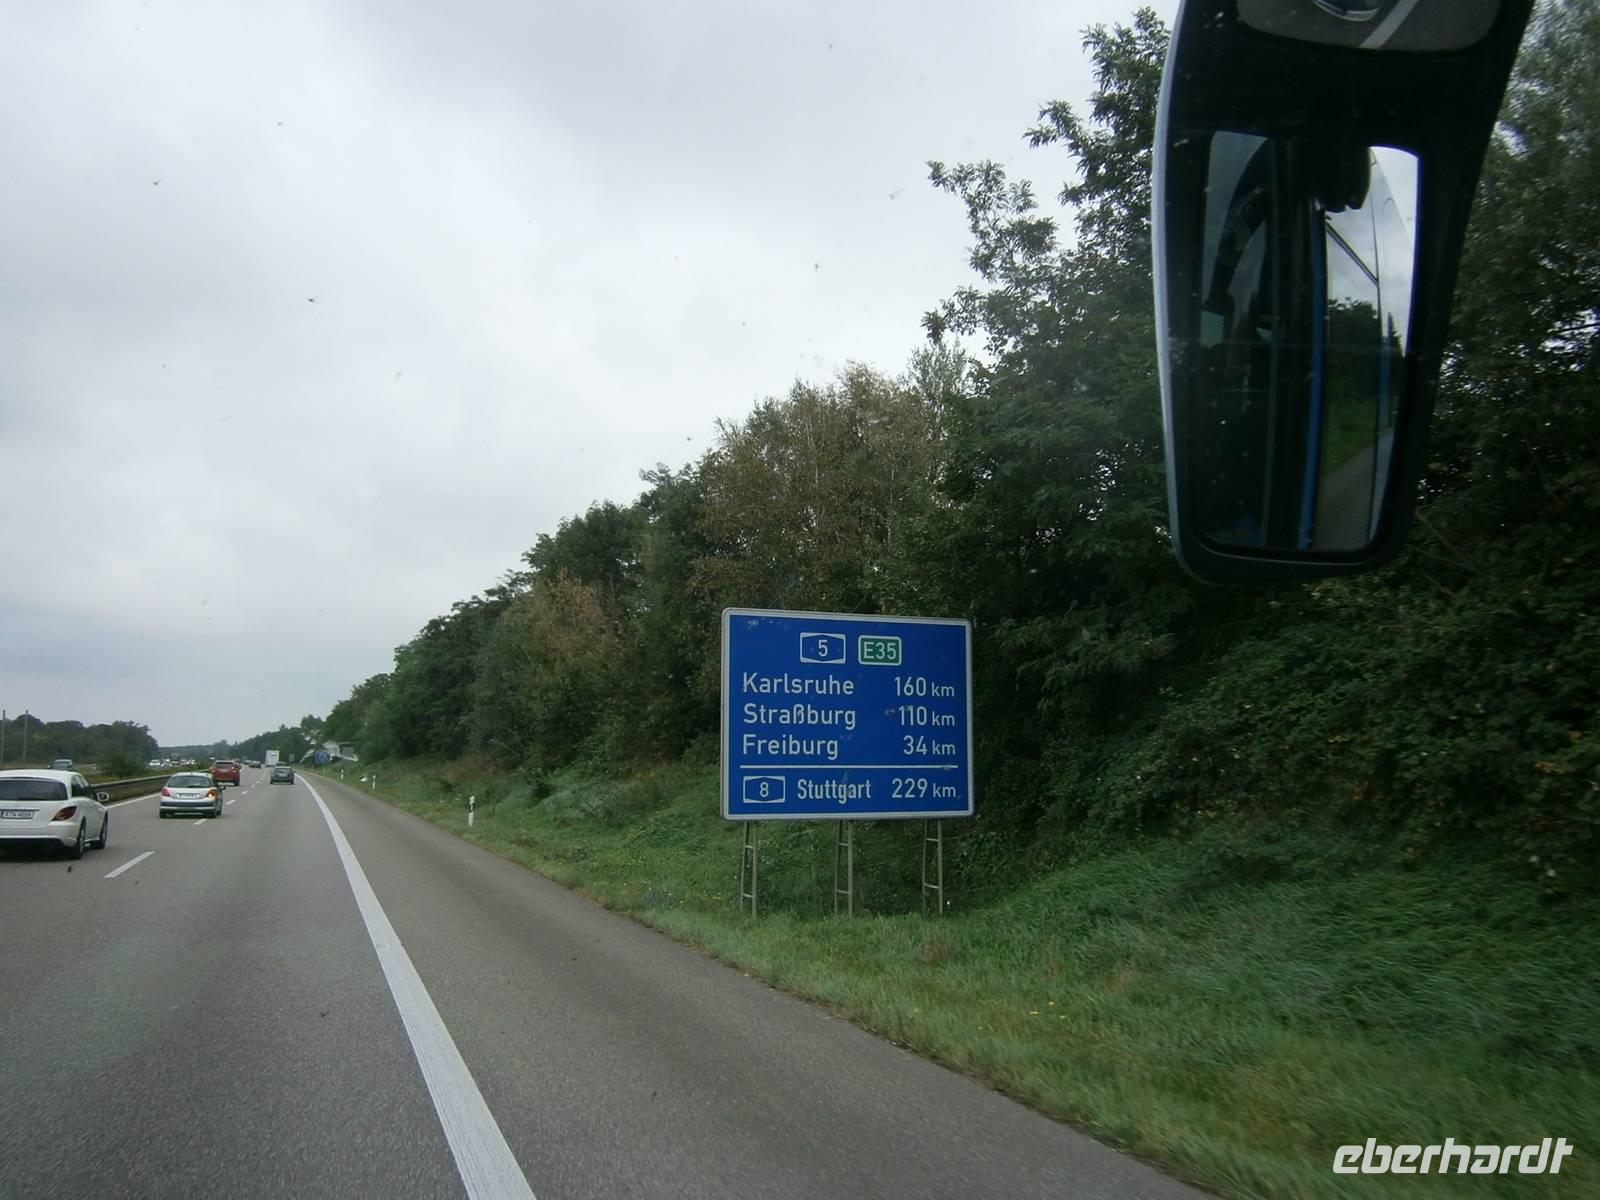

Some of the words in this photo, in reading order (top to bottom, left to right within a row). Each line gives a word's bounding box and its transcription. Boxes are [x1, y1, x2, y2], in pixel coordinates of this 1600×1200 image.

[818, 640, 827, 656] 5
[863, 642, 896, 659] E35
[743, 673, 854, 695] Karlsruhe
[895, 677, 926, 696] 160
[932, 684, 954, 696] km
[744, 703, 856, 730] Straßburg
[898, 706, 927, 725] 110
[932, 713, 955, 726] km
[743, 734, 838, 760] Freiburg
[903, 736, 927, 755] 34
[933, 742, 955, 755] km
[760, 782, 768, 797] 8
[797, 780, 871, 804] Stuttgart
[892, 779, 927, 798] 229
[933, 784, 956, 798] km
